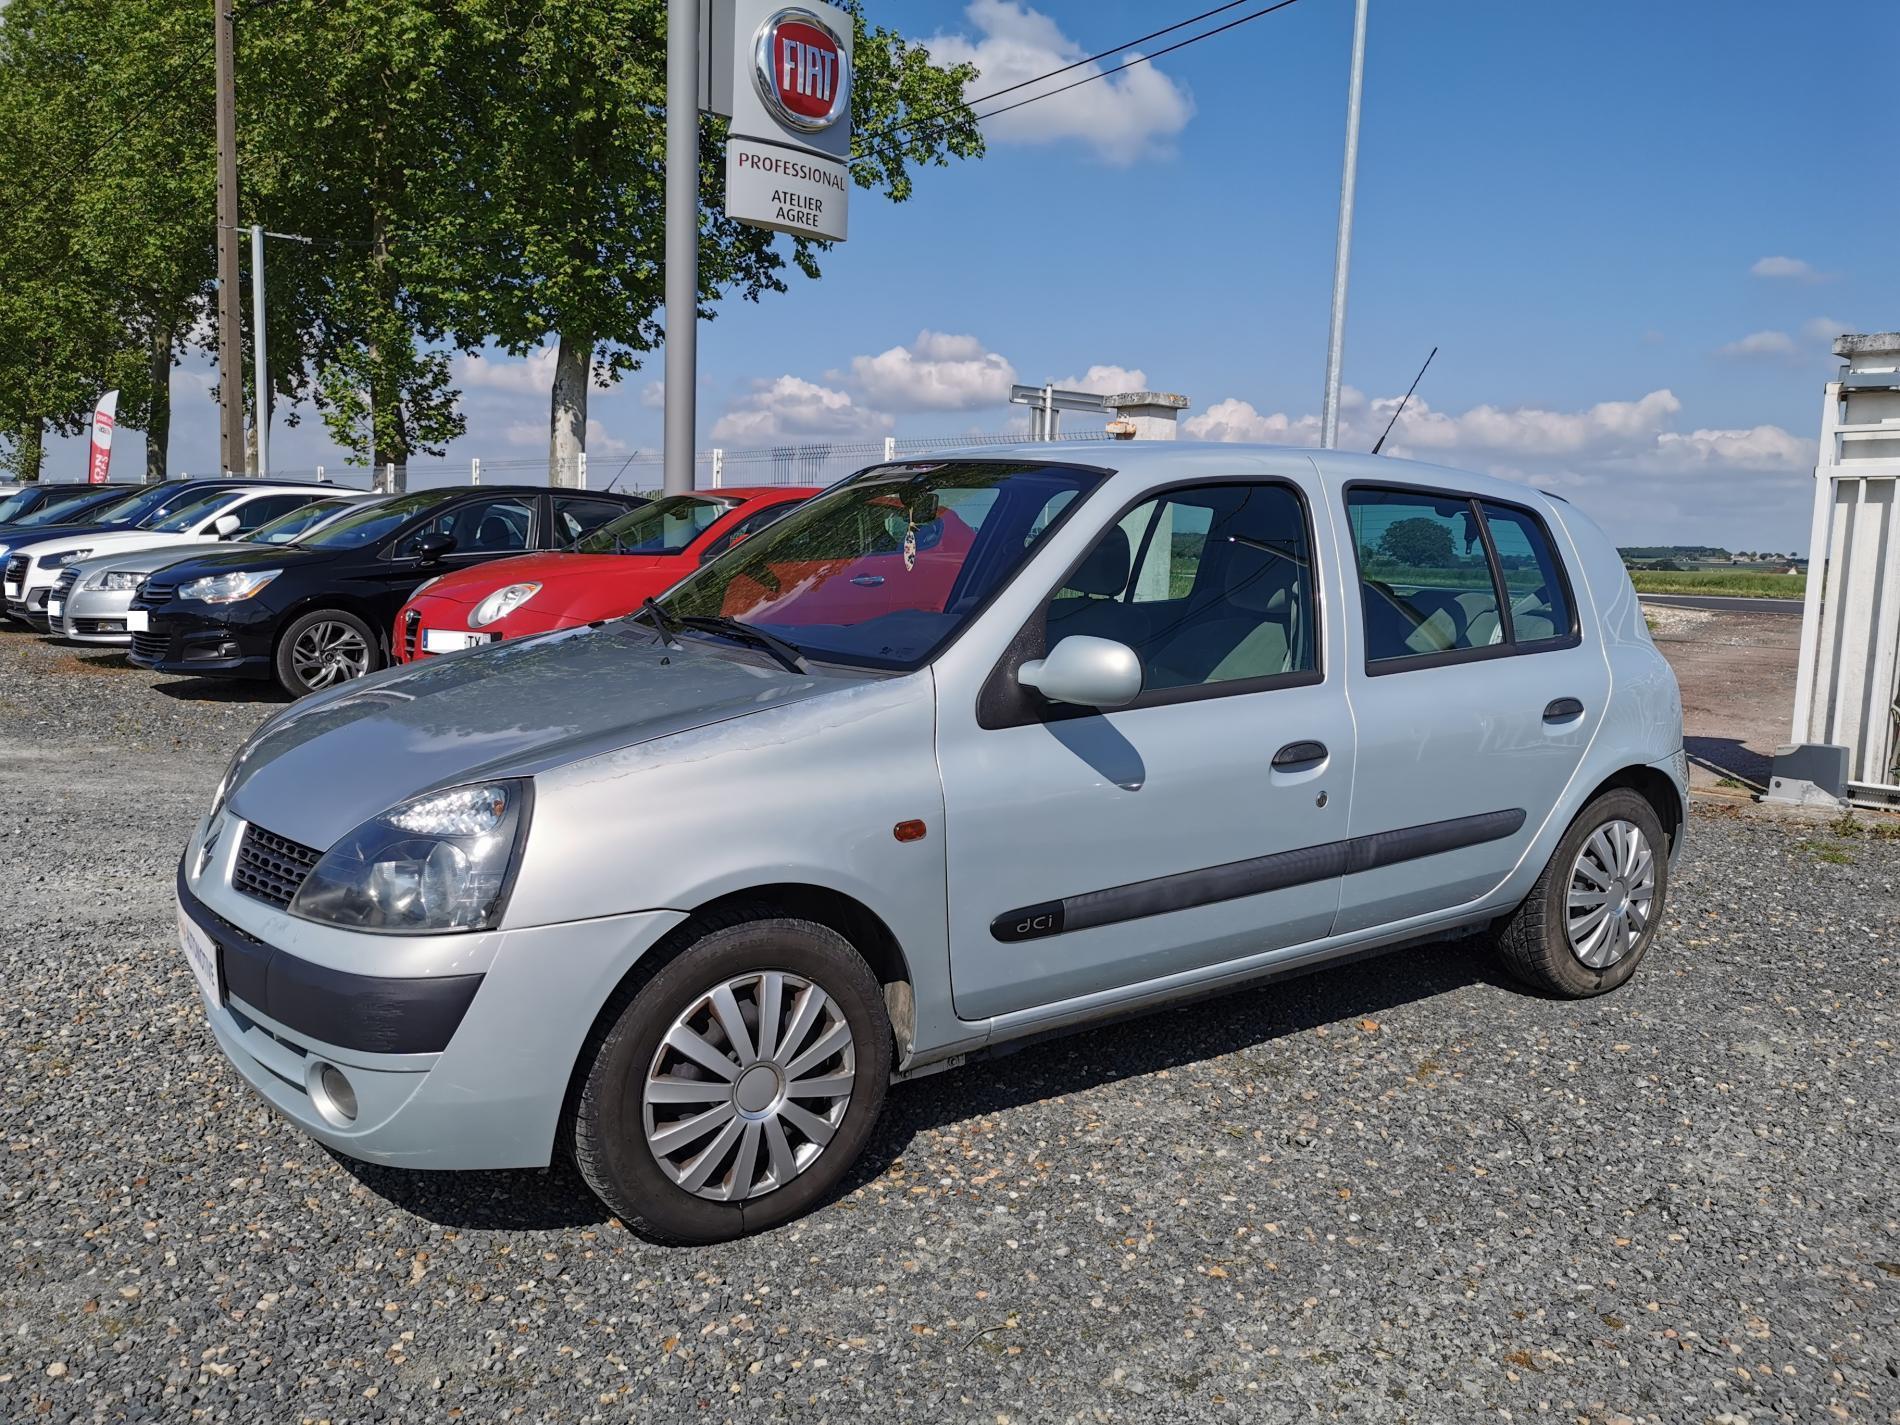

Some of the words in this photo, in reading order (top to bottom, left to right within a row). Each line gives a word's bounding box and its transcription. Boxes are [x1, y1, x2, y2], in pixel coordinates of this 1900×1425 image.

[782, 37, 835, 101] FIAT
[738, 152, 845, 192] PROFESSIONAL
[771, 190, 823, 213] ATELIER
[775, 206, 819, 228] AGREE
